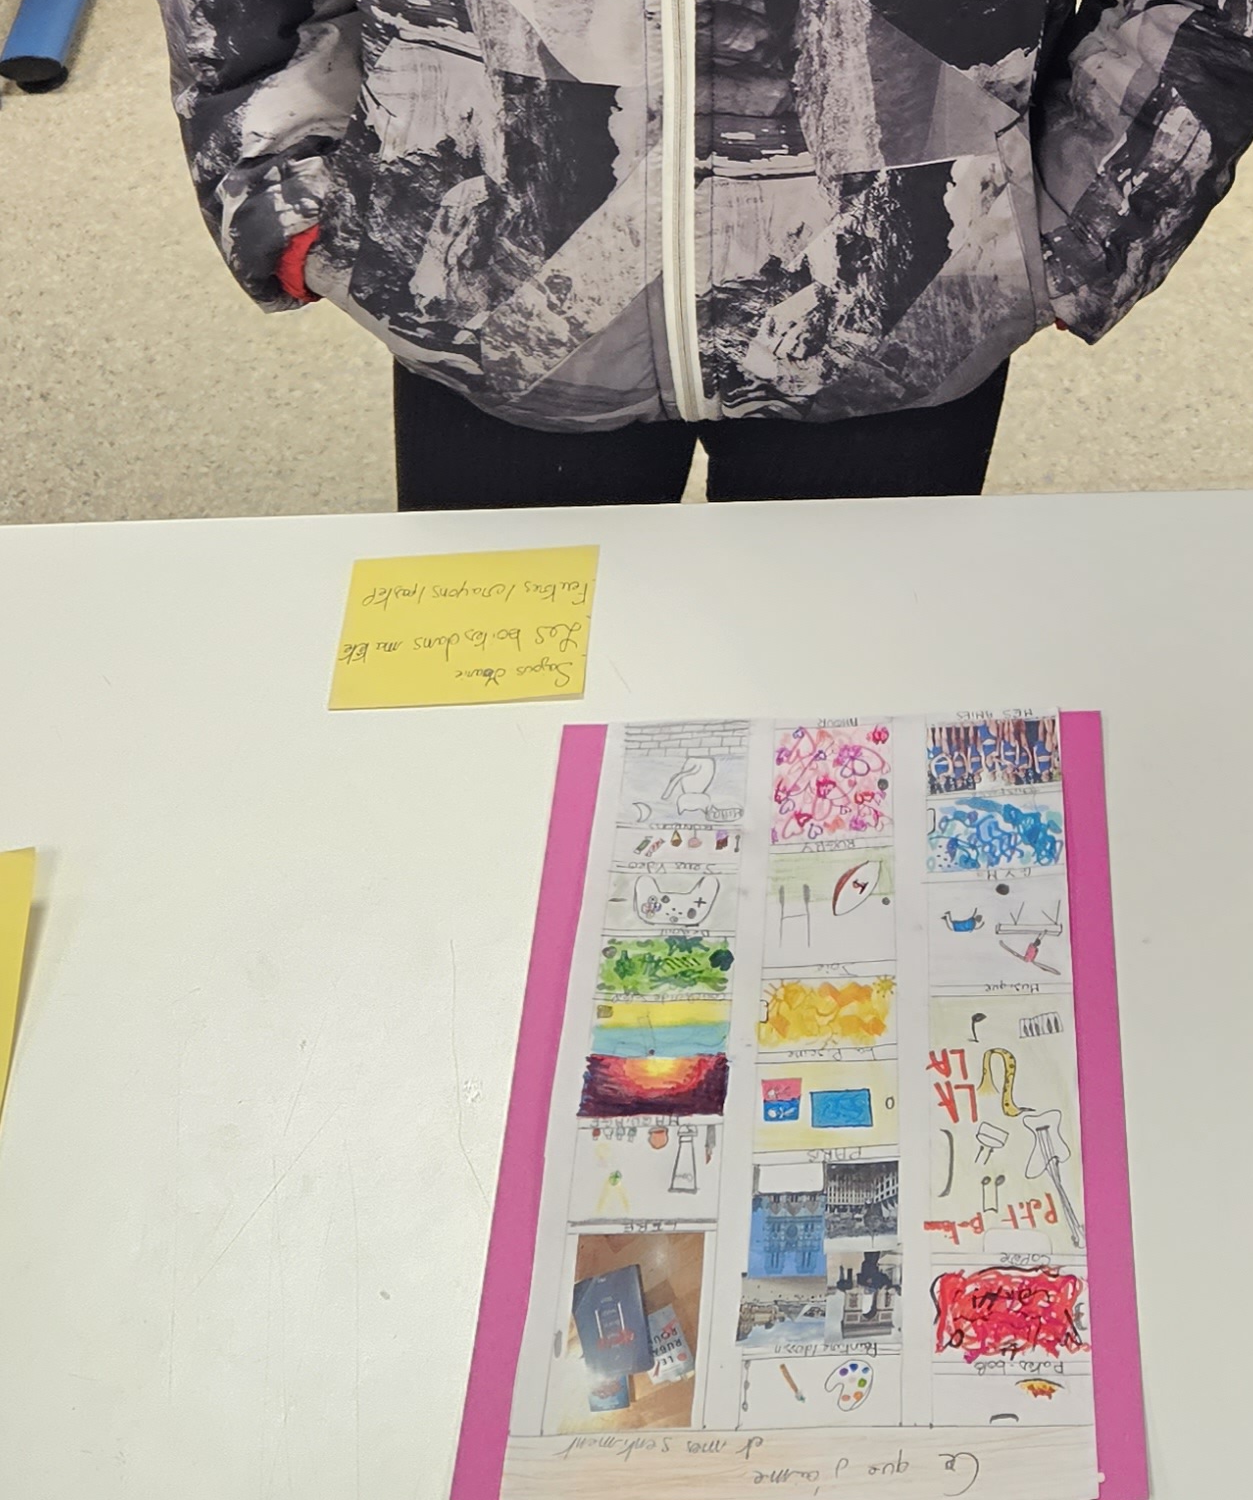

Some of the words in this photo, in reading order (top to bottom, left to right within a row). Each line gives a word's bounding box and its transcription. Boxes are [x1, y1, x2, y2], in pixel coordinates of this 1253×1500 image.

[375, 640, 403, 653] ma
[412, 632, 460, 663] dans
[534, 621, 582, 653] Les
[925, 1048, 969, 1081] LA
[933, 1080, 978, 1124] LA
[1000, 1192, 1059, 1230] Petit
[649, 1338, 682, 1358] RUBA
[686, 1437, 728, 1456] mes
[733, 1435, 764, 1459] et
[866, 1449, 911, 1479] que
